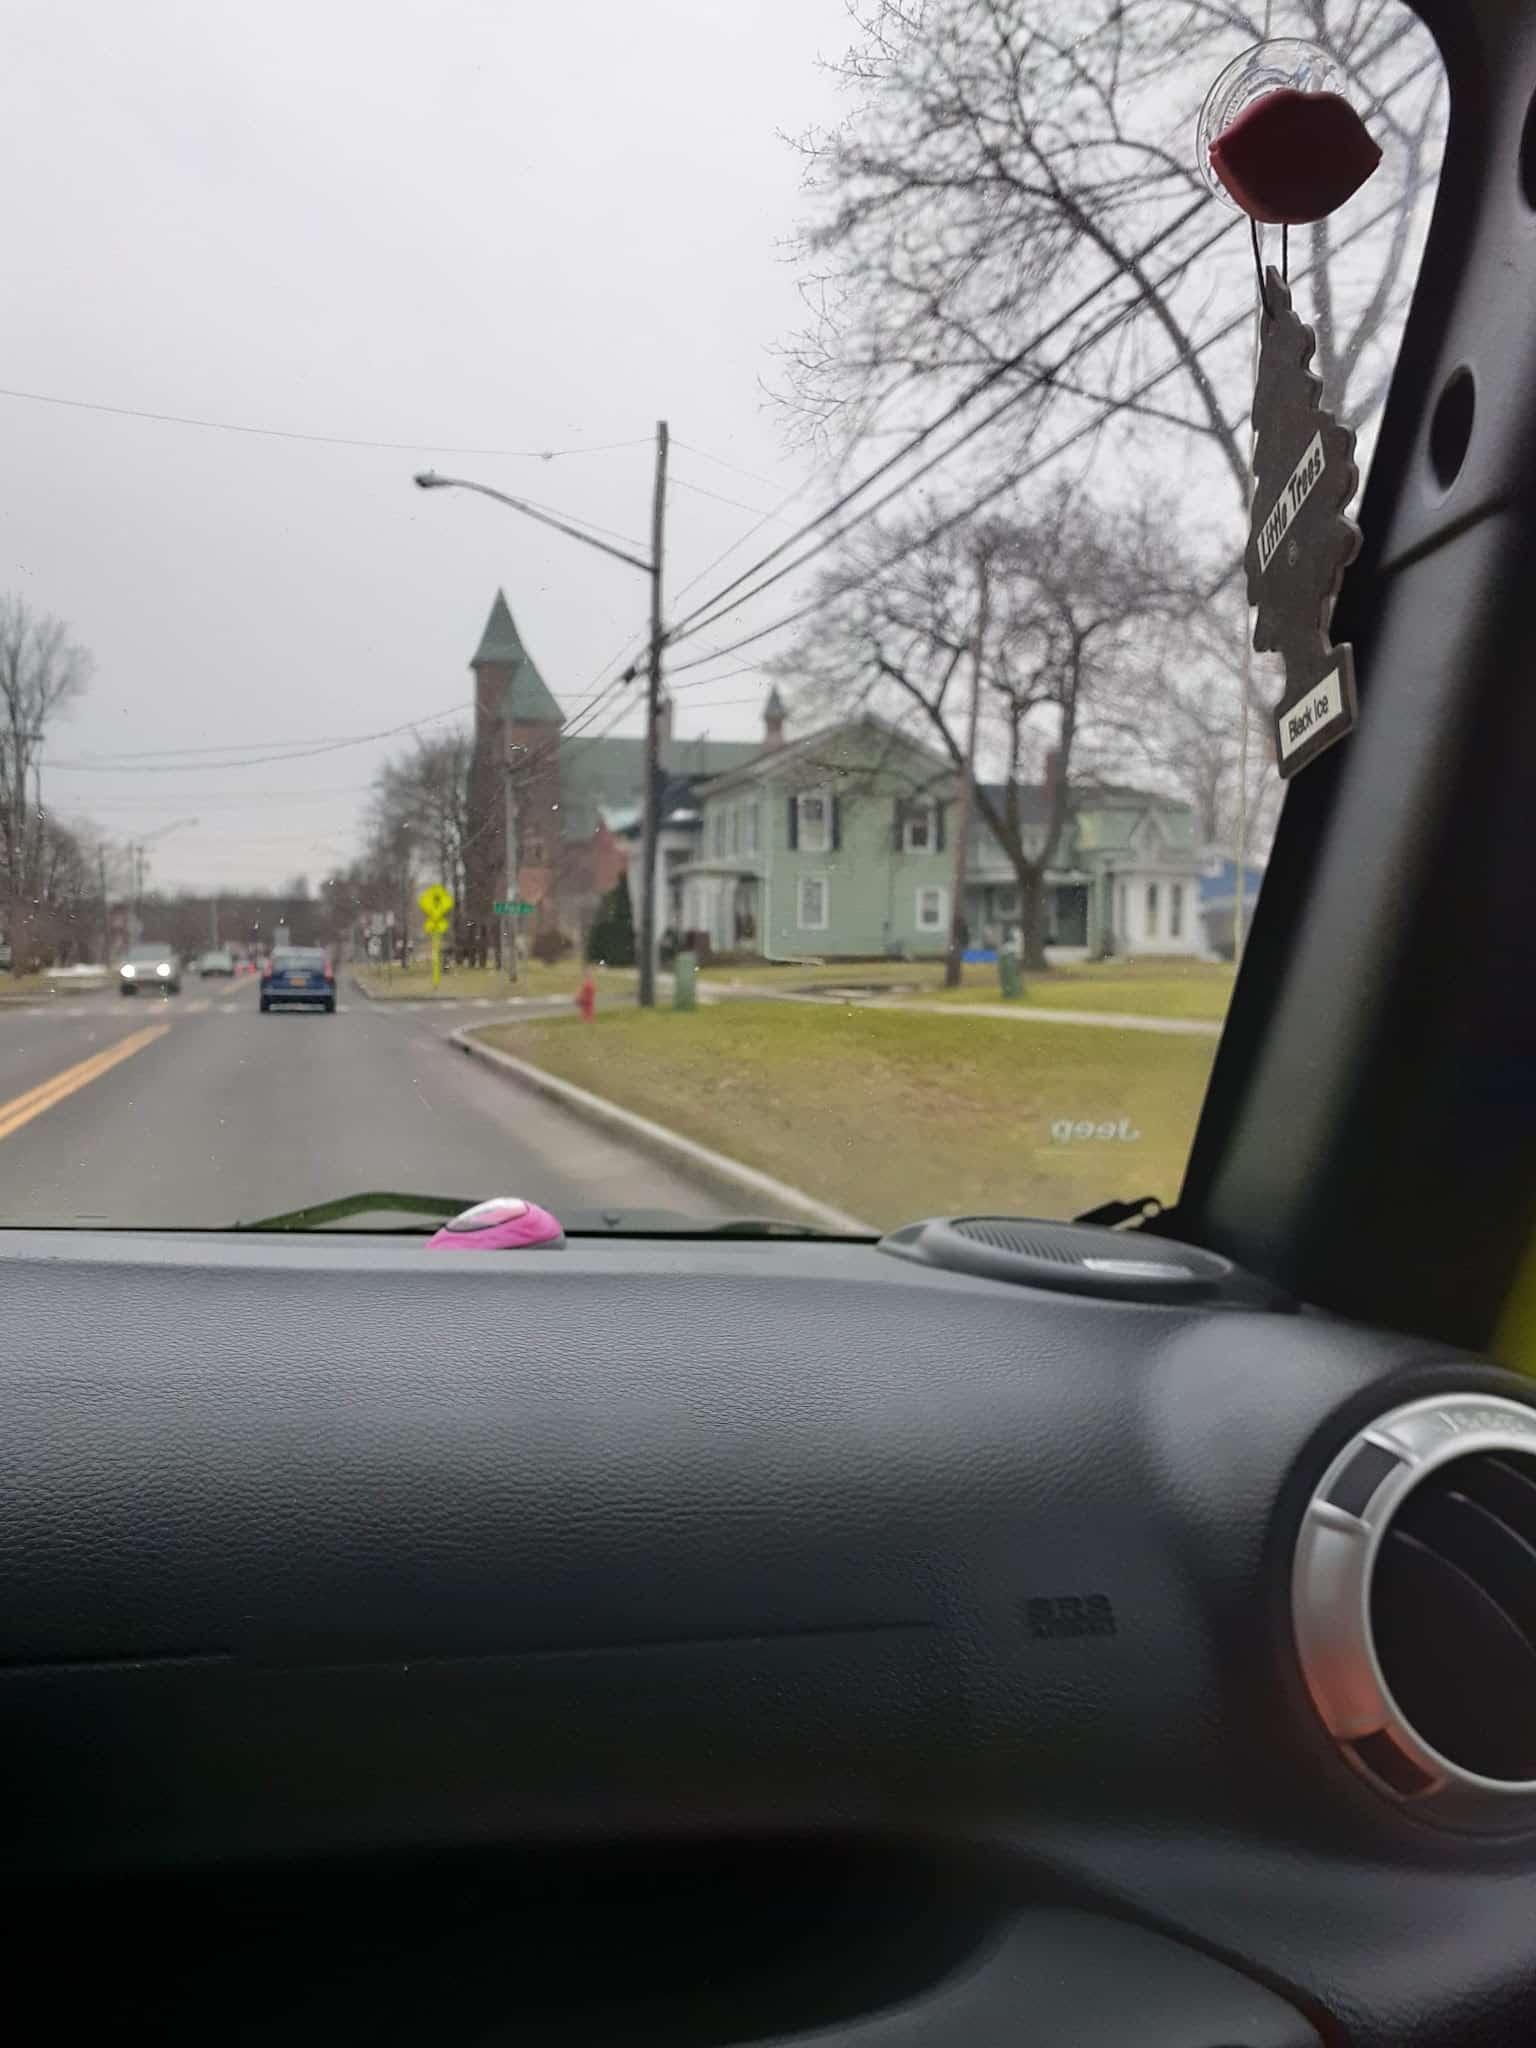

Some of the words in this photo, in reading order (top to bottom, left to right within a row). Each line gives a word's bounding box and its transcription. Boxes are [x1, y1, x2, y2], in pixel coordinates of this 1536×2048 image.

[1260, 501, 1287, 564] Little
[1288, 447, 1321, 513] Trees
[1288, 705, 1313, 742] Black
[1314, 695, 1328, 721] Ice
